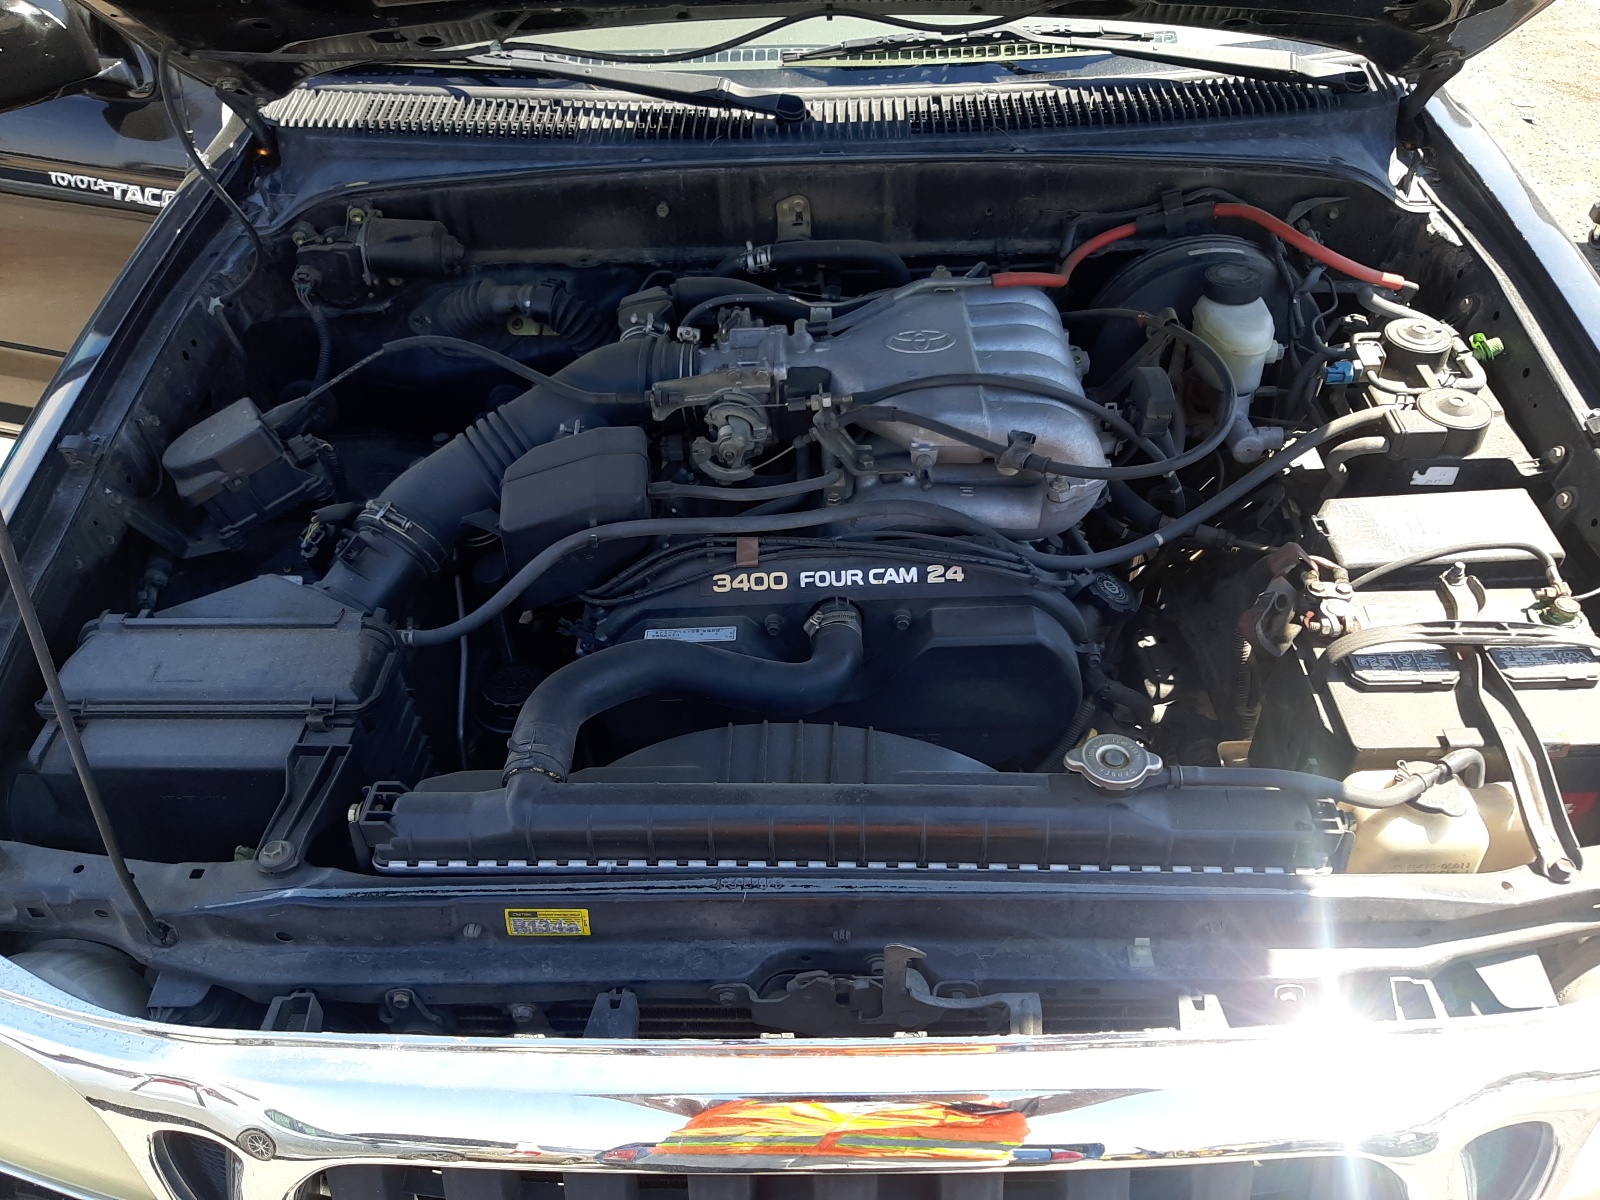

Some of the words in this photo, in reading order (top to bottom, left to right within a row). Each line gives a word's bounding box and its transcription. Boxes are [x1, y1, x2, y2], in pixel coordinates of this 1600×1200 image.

[47, 171, 108, 192] TOYOTA
[712, 571, 789, 593] 3400
[800, 568, 864, 588] FOUR
[868, 566, 918, 587] CAM
[926, 564, 965, 583] 24
